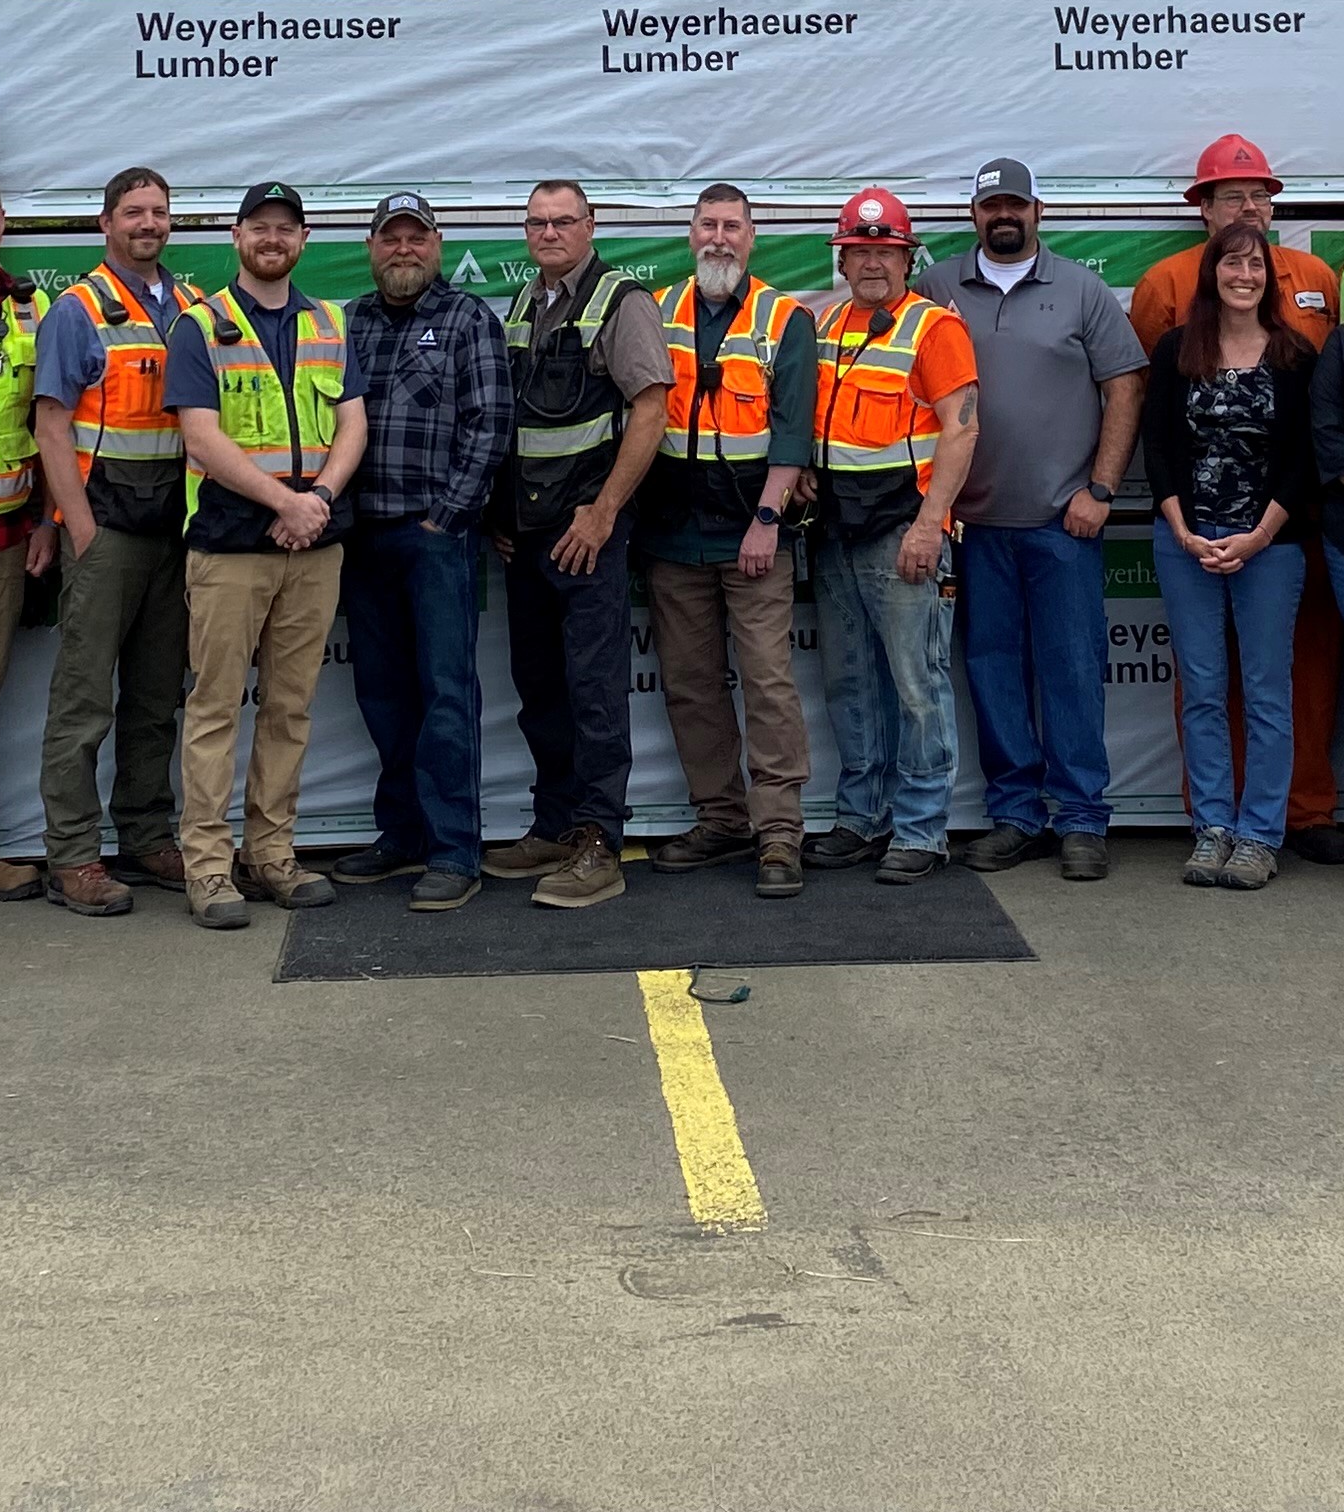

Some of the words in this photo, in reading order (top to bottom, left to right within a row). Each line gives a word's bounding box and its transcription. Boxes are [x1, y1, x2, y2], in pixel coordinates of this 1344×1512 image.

[136, 11, 401, 47] Weyerhaeuser
[602, 7, 858, 42] Weyerhaeuser
[1054, 5, 1305, 40] Weyerhaeuser
[136, 49, 279, 78] Lumber
[602, 44, 739, 73] Lumber
[1054, 42, 1188, 70] Lumber
